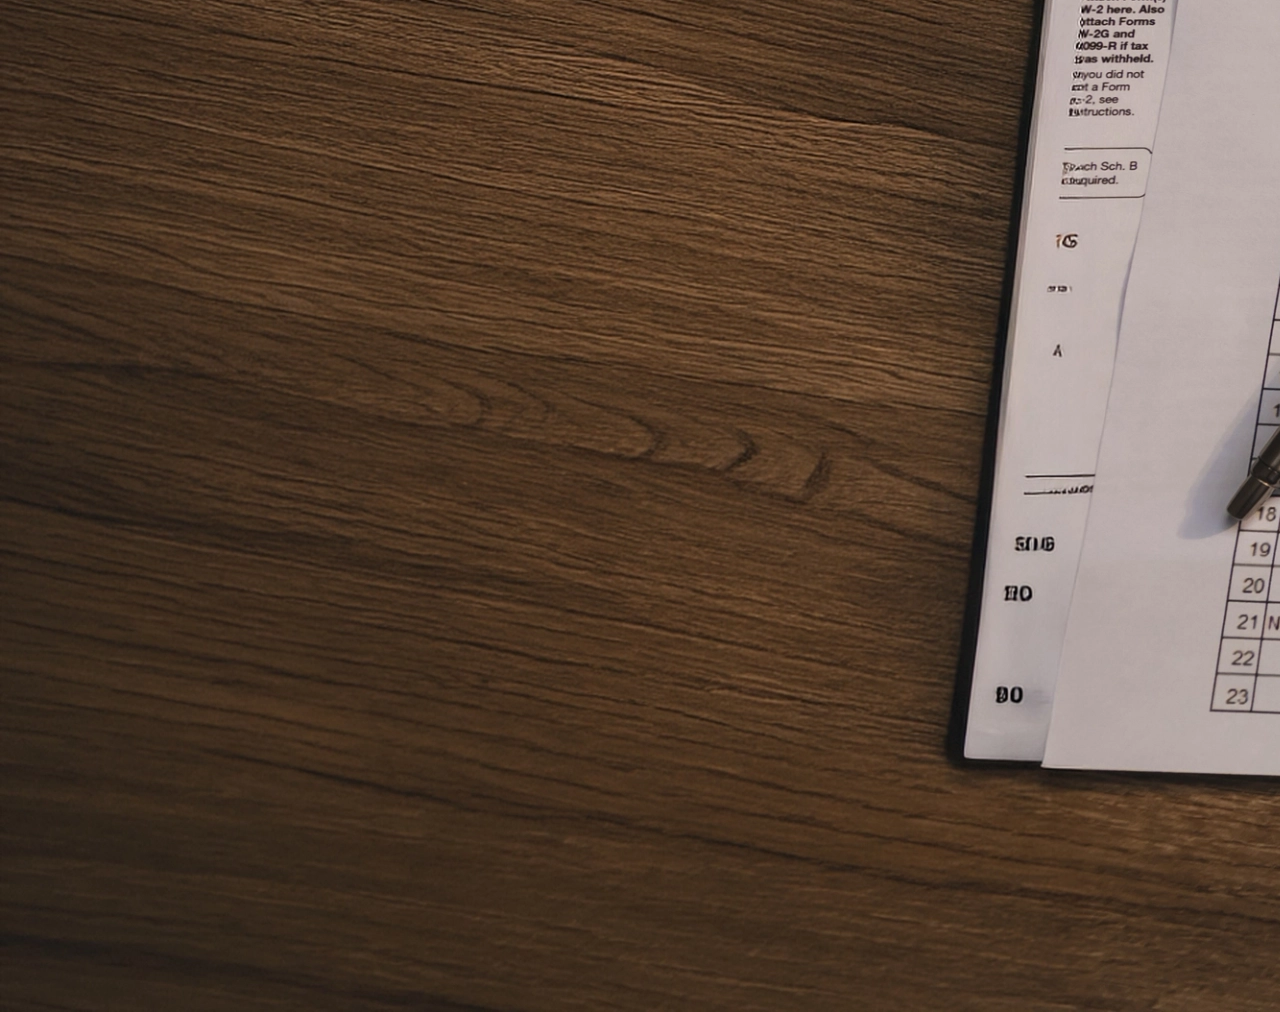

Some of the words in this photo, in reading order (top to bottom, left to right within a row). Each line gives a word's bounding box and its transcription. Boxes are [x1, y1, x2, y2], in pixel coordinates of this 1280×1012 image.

[1250, 541, 1272, 558] 19
[1241, 576, 1266, 594] 20
[1236, 613, 1258, 631] 21
[1230, 649, 1255, 667] 22
[1224, 687, 1249, 706] 23
